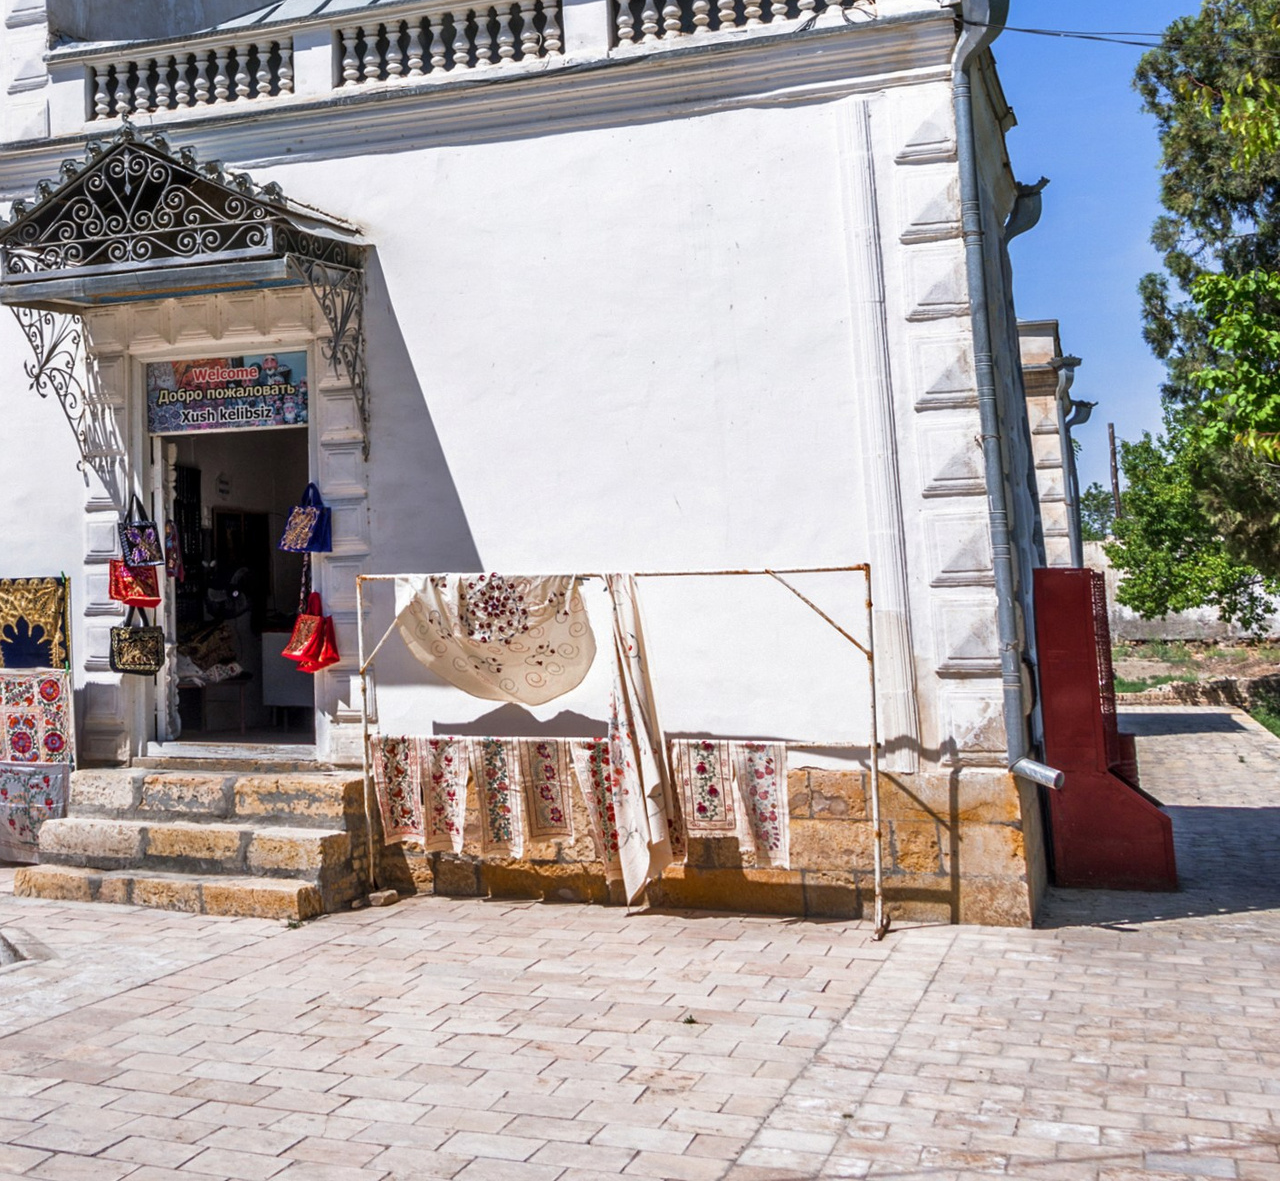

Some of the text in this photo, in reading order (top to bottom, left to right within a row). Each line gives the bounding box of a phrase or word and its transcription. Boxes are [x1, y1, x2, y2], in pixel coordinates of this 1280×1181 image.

[192, 366, 258, 382] Welcome
[158, 383, 296, 405] Добро пожаловать
[181, 405, 273, 424] Xush kelibsiz
